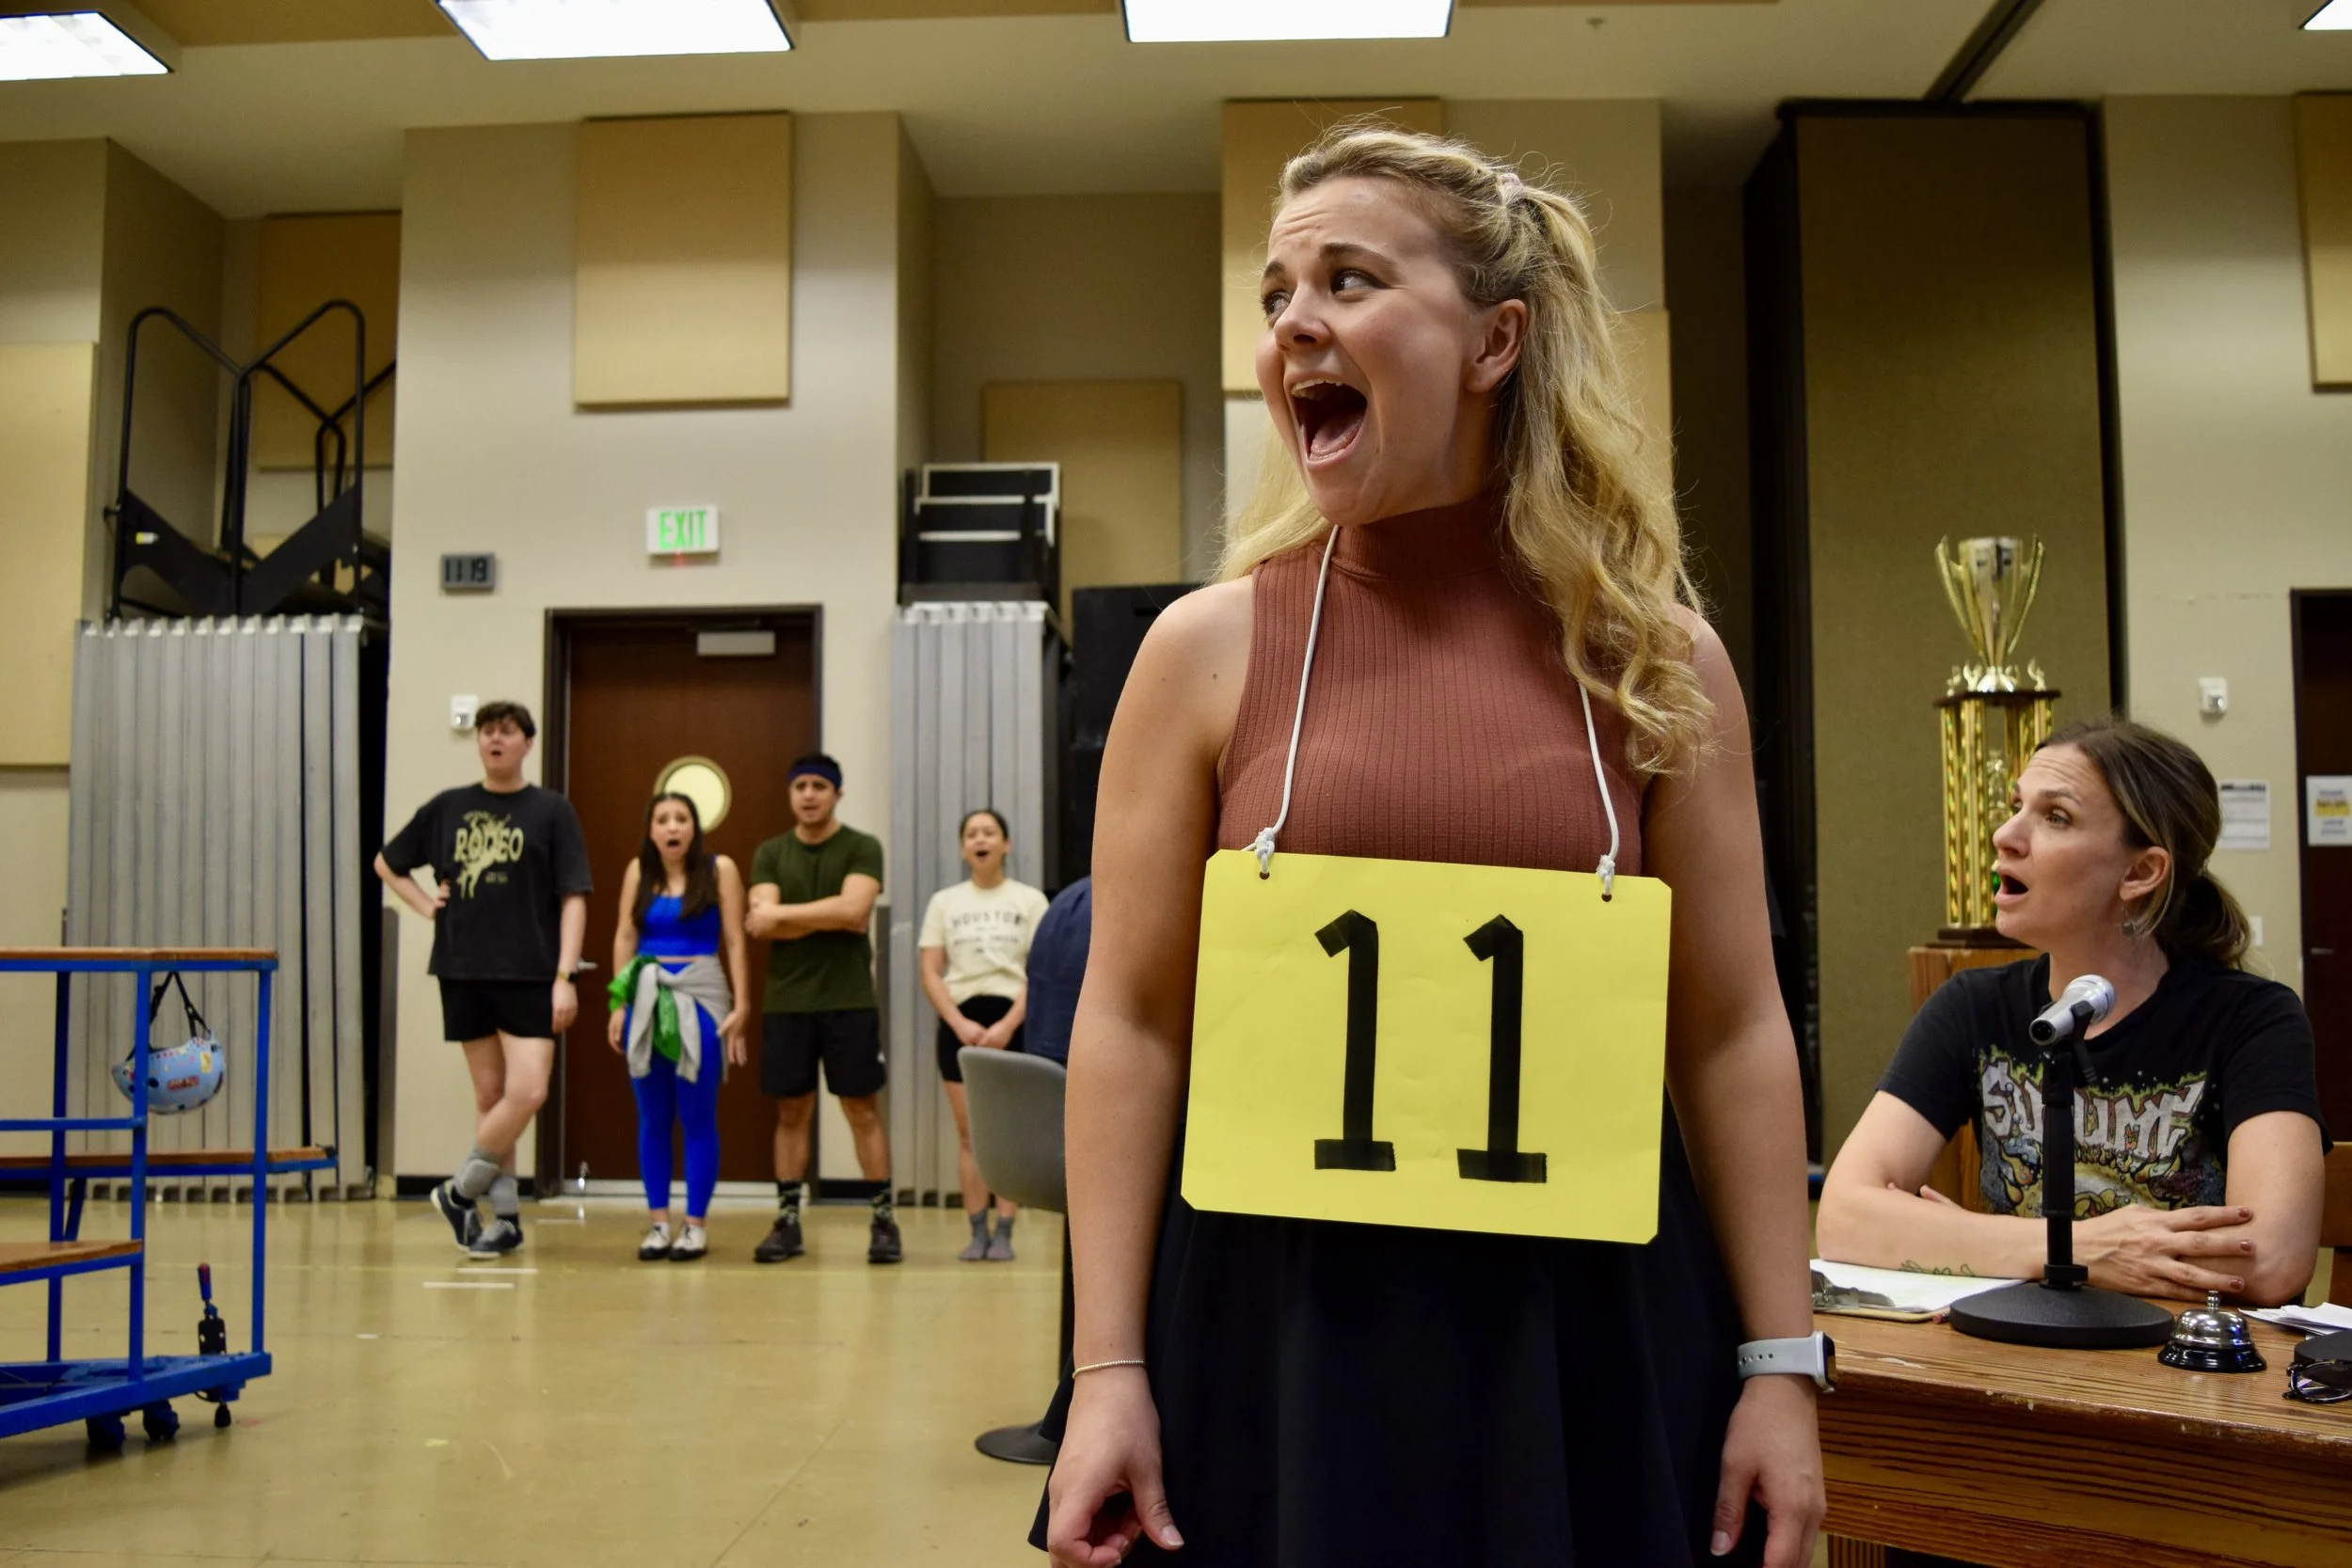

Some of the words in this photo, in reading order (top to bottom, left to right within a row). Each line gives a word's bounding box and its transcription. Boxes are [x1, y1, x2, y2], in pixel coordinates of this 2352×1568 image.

[660, 510, 707, 549] EXIT
[453, 827, 525, 863] RODEO
[1314, 909, 1549, 1184] 11
[1981, 1059, 2207, 1164] SULIME
